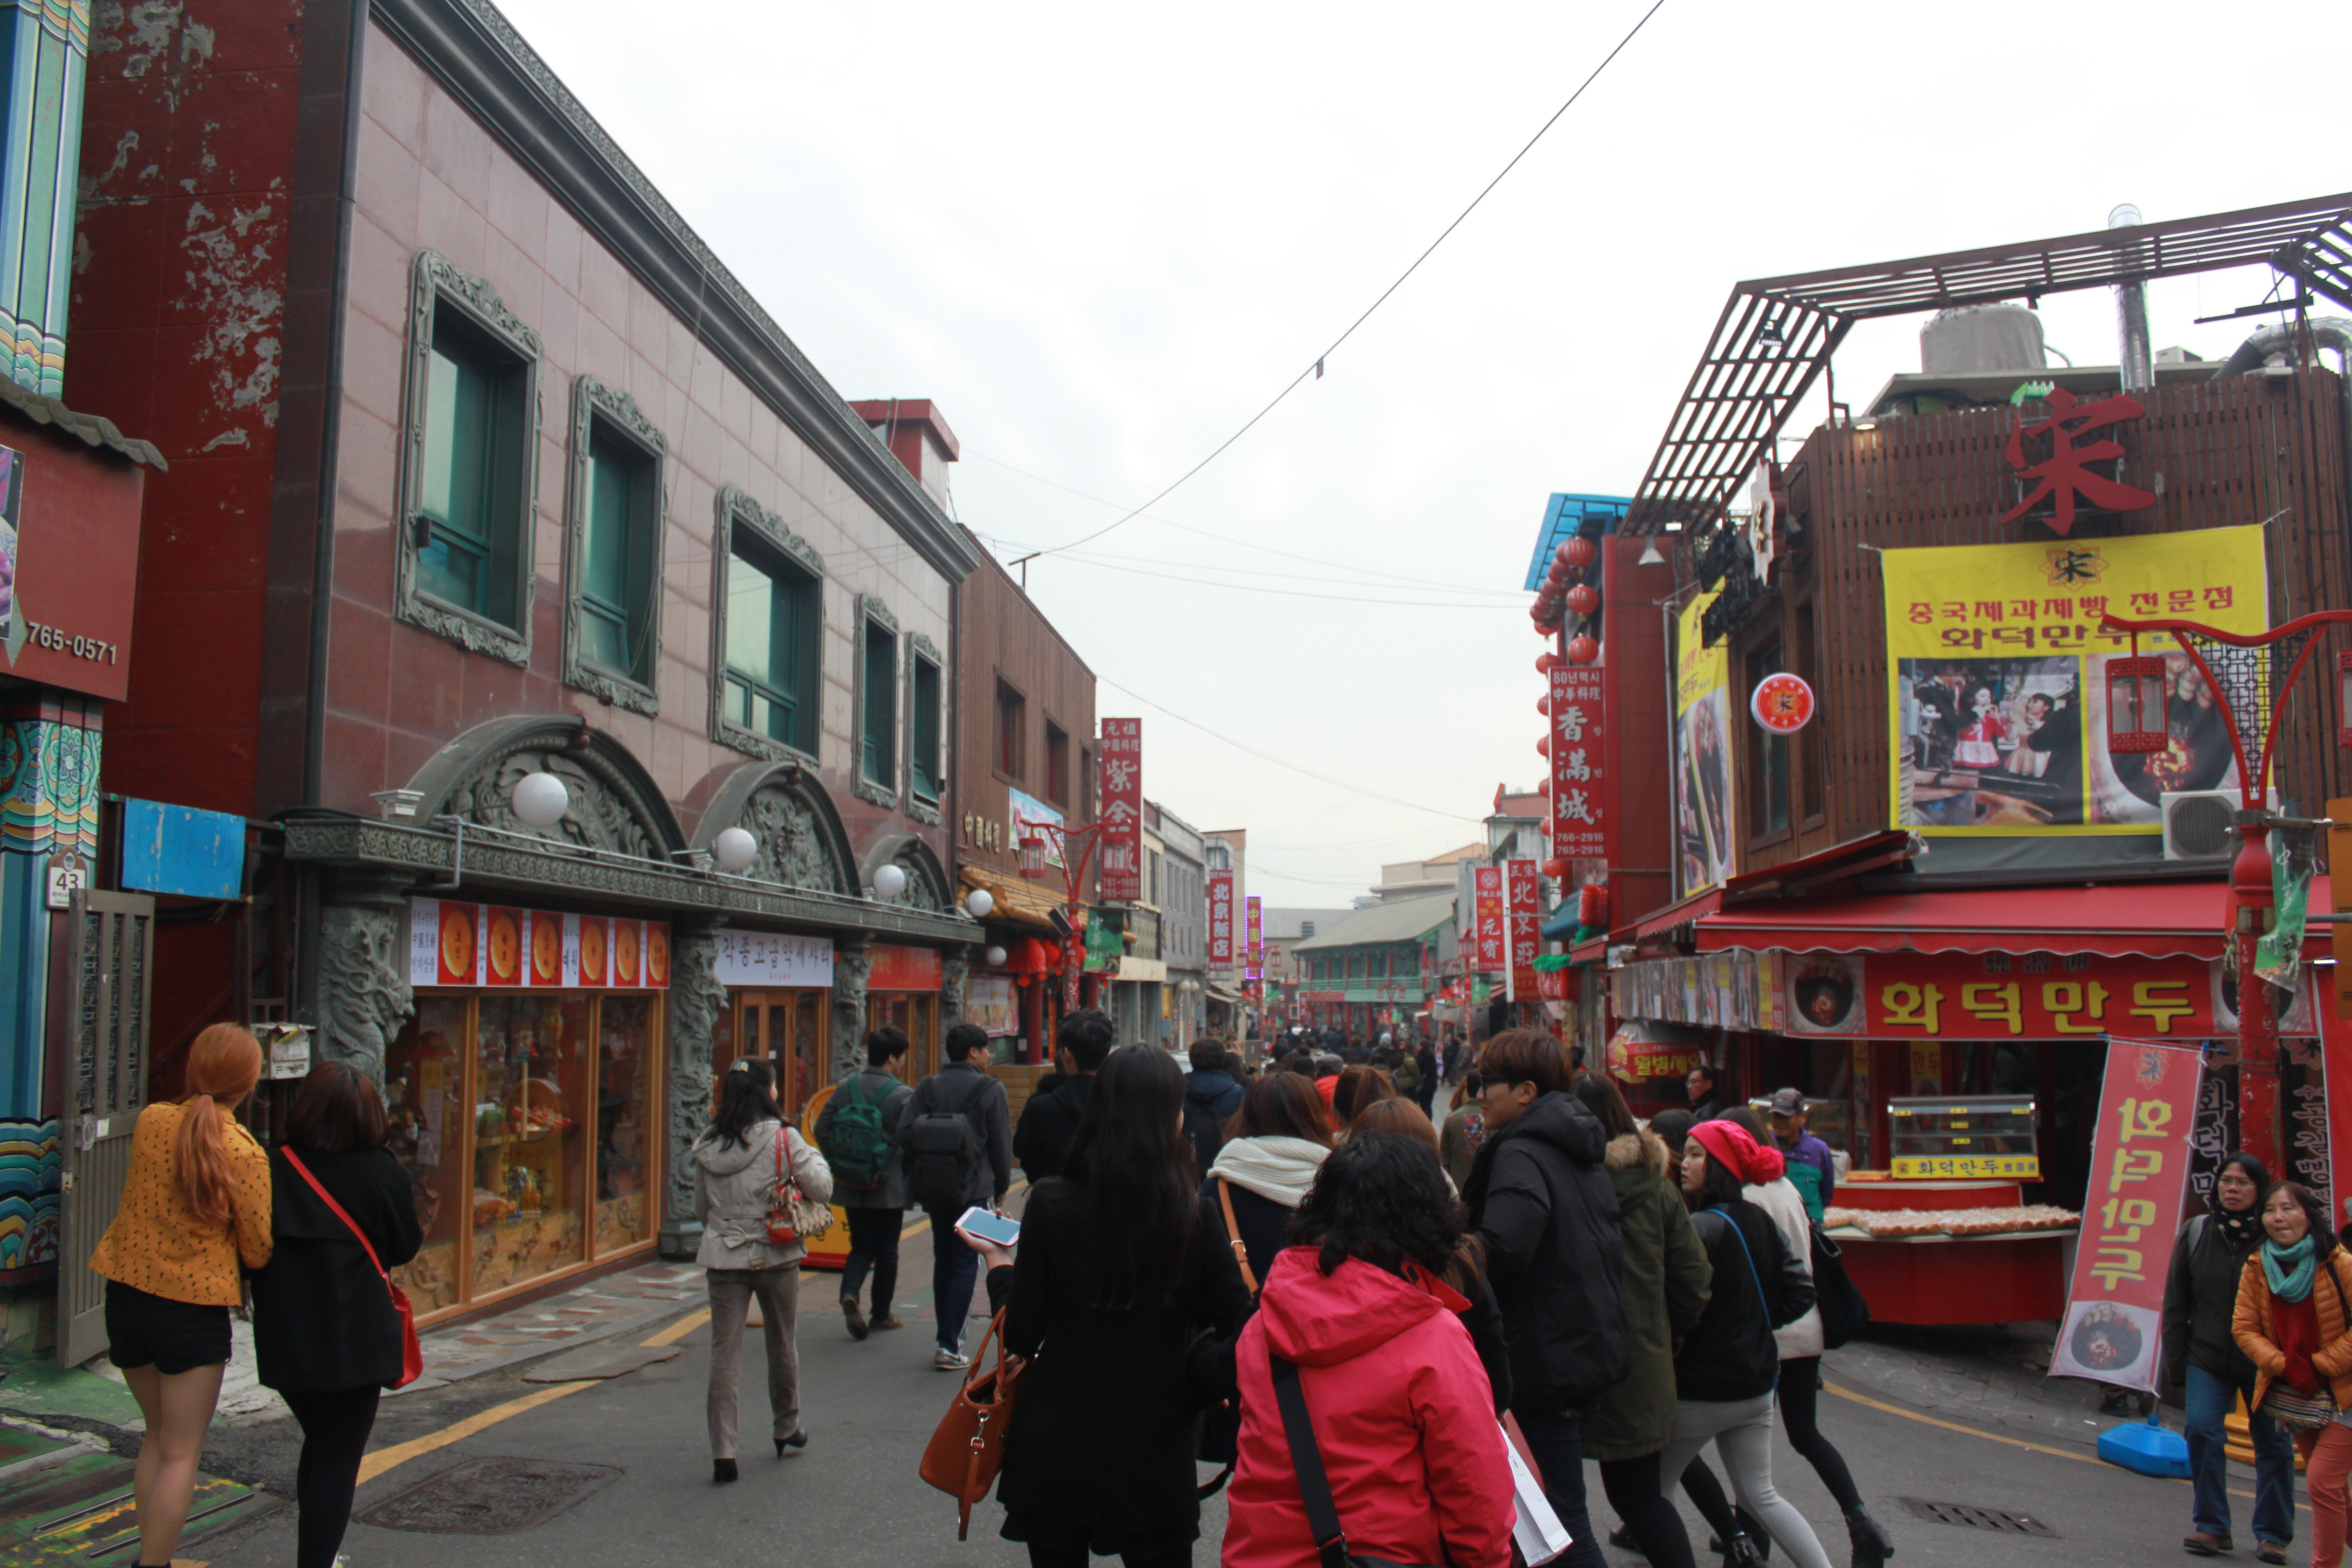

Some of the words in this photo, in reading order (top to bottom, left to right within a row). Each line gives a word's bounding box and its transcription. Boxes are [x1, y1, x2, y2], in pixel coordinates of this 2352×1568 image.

[2000, 387, 2156, 535] 宋
[2054, 550, 2100, 584] 宋
[1908, 594, 2110, 625] 중국제과제빵
[2129, 586, 2234, 615] 전문점
[28, 621, 117, 665] 765-0571
[1553, 671, 1600, 684] 80년역사
[1553, 686, 1601, 702] 中華料理
[1557, 706, 1595, 826] 香滿城
[1104, 758, 1138, 874] 紫金
[1556, 832, 1604, 841] 766-2916
[1557, 845, 1604, 855] 765-2916
[56, 873, 79, 890] 43
[1213, 883, 1230, 957] 北京飯店
[1882, 980, 2194, 1034] 화덕만두
[1917, 1159, 1999, 1176] 화덕만두
